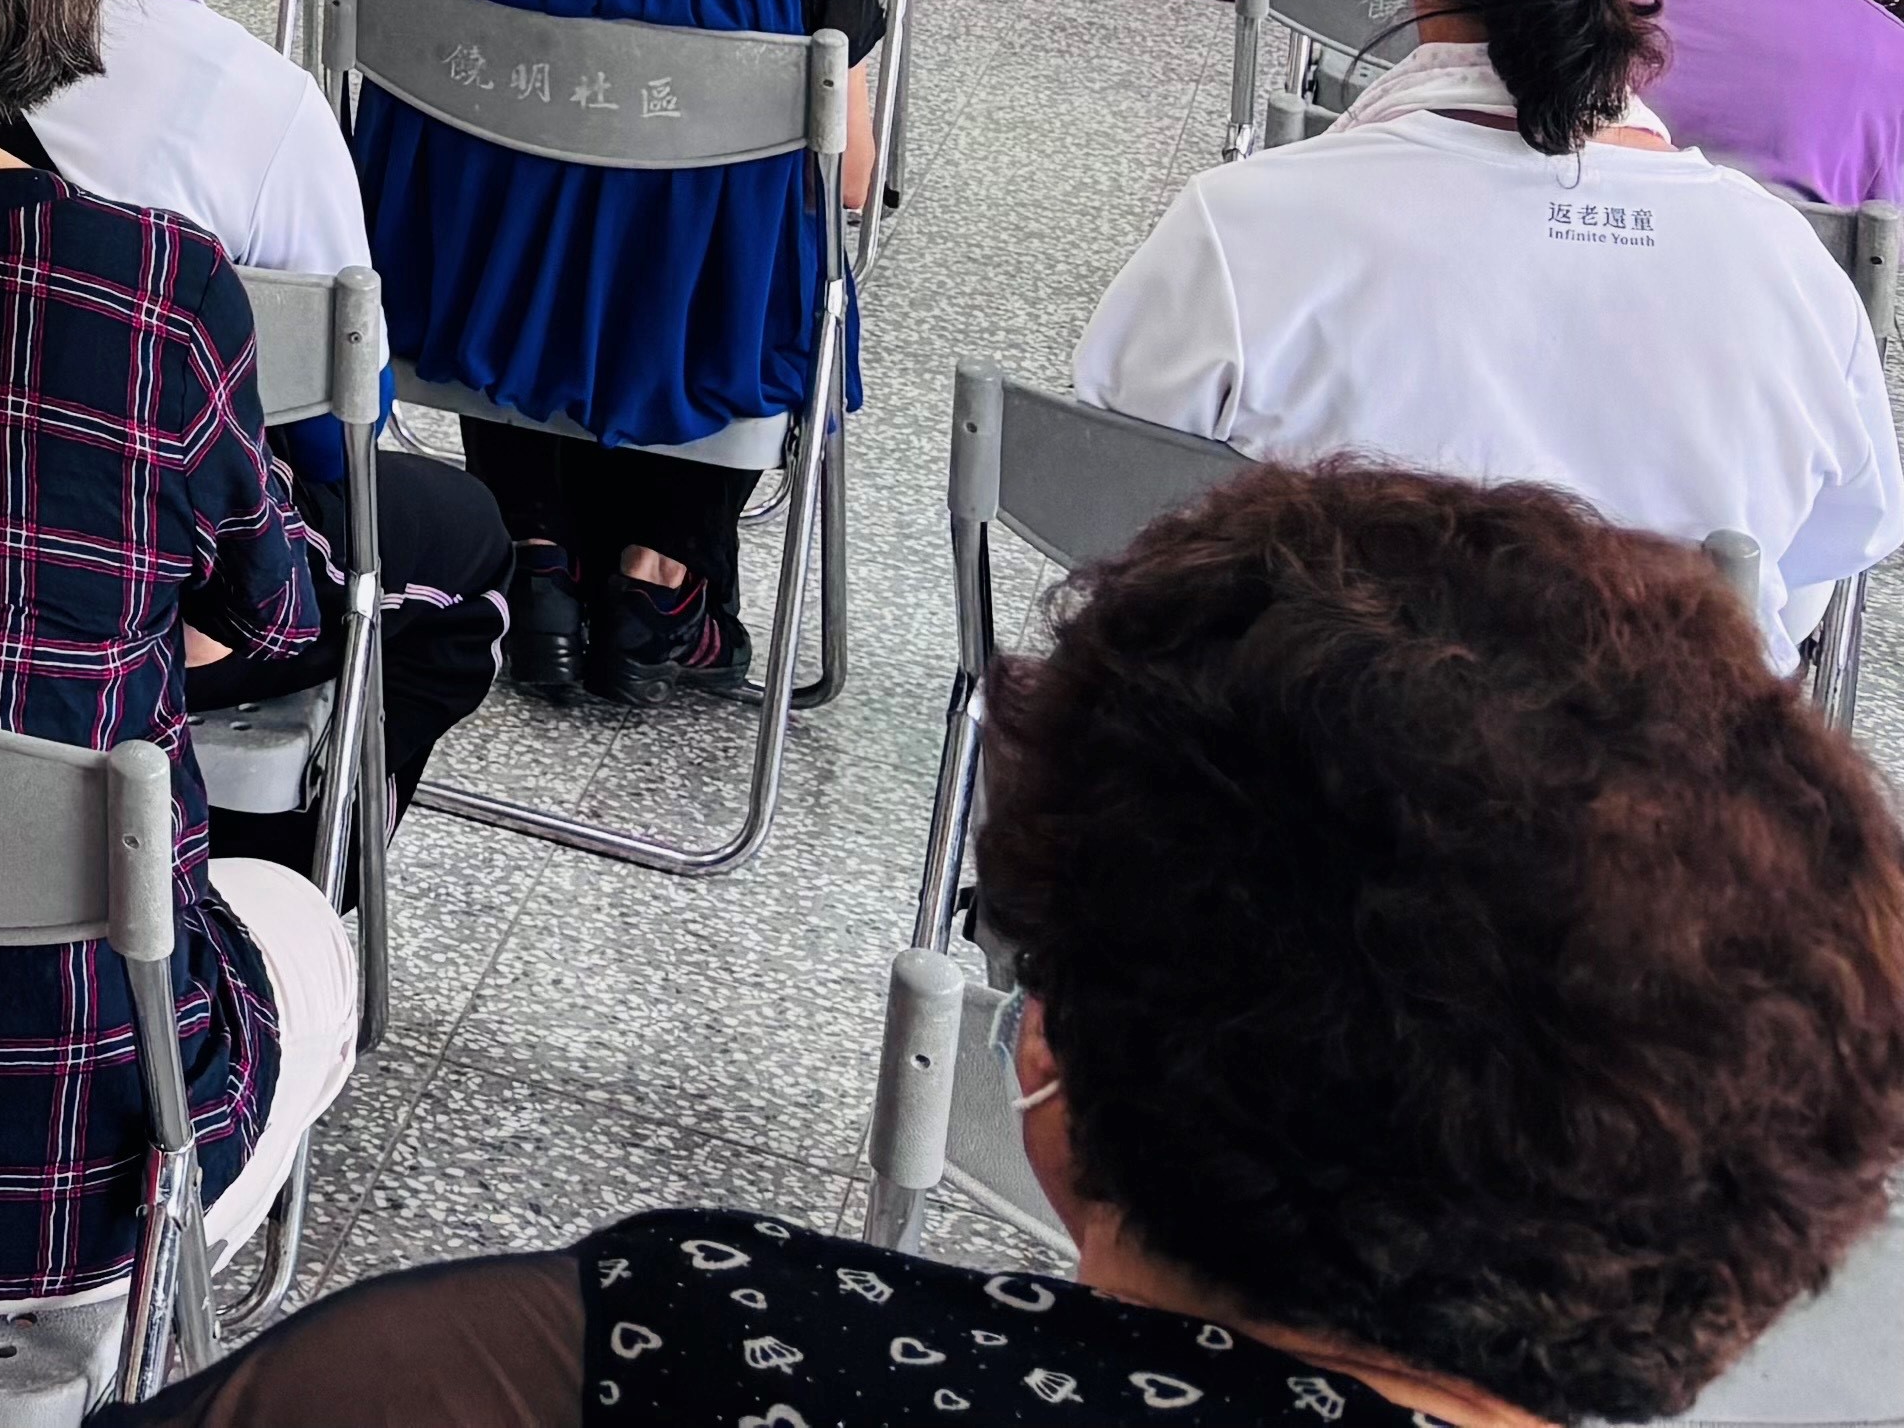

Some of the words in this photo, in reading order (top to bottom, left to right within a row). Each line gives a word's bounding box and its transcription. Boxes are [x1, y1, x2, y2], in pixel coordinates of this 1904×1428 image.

[440, 41, 683, 120] 饒明社區
[1547, 200, 1656, 233] 返老還童
[1547, 226, 1608, 247] Infinite
[1610, 230, 1656, 248] Youth
